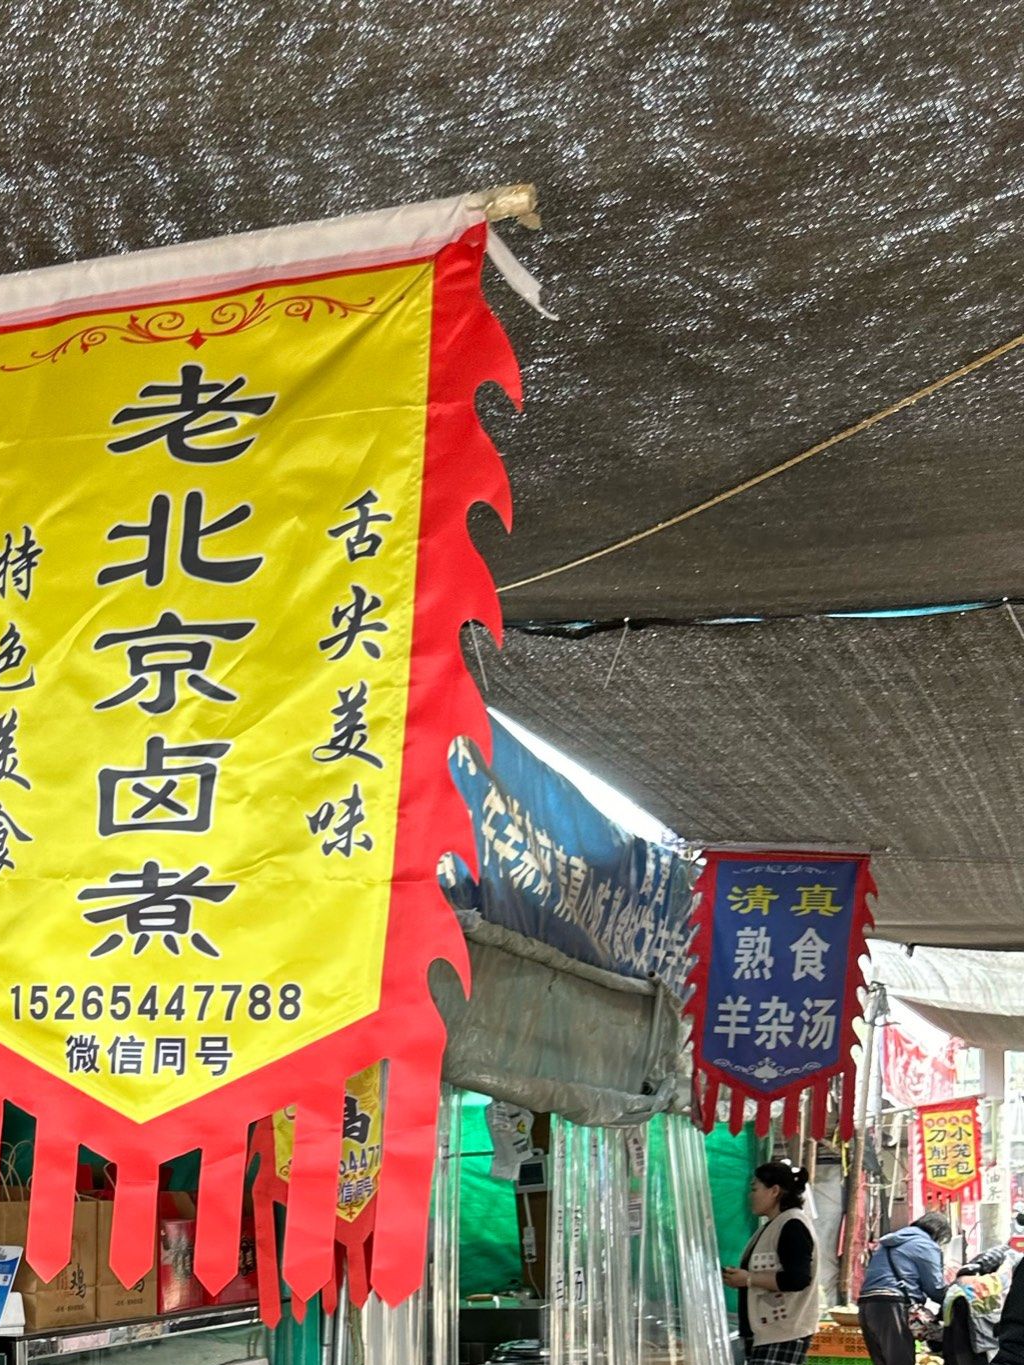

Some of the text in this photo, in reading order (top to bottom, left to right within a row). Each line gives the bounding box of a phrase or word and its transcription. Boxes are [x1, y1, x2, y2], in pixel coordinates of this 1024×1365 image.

[77, 364, 277, 957] 老北京卤煮
[306, 489, 393, 858] 舌尖美味
[727, 884, 843, 917] 清真
[733, 926, 830, 982] 熟食
[9, 984, 303, 1022] 15265447788
[713, 995, 837, 1050] 羊杂汤
[65, 1036, 234, 1077] 微信同号
[928, 1129, 949, 1179] 刀削面
[950, 1127, 973, 1175] 小笼包
